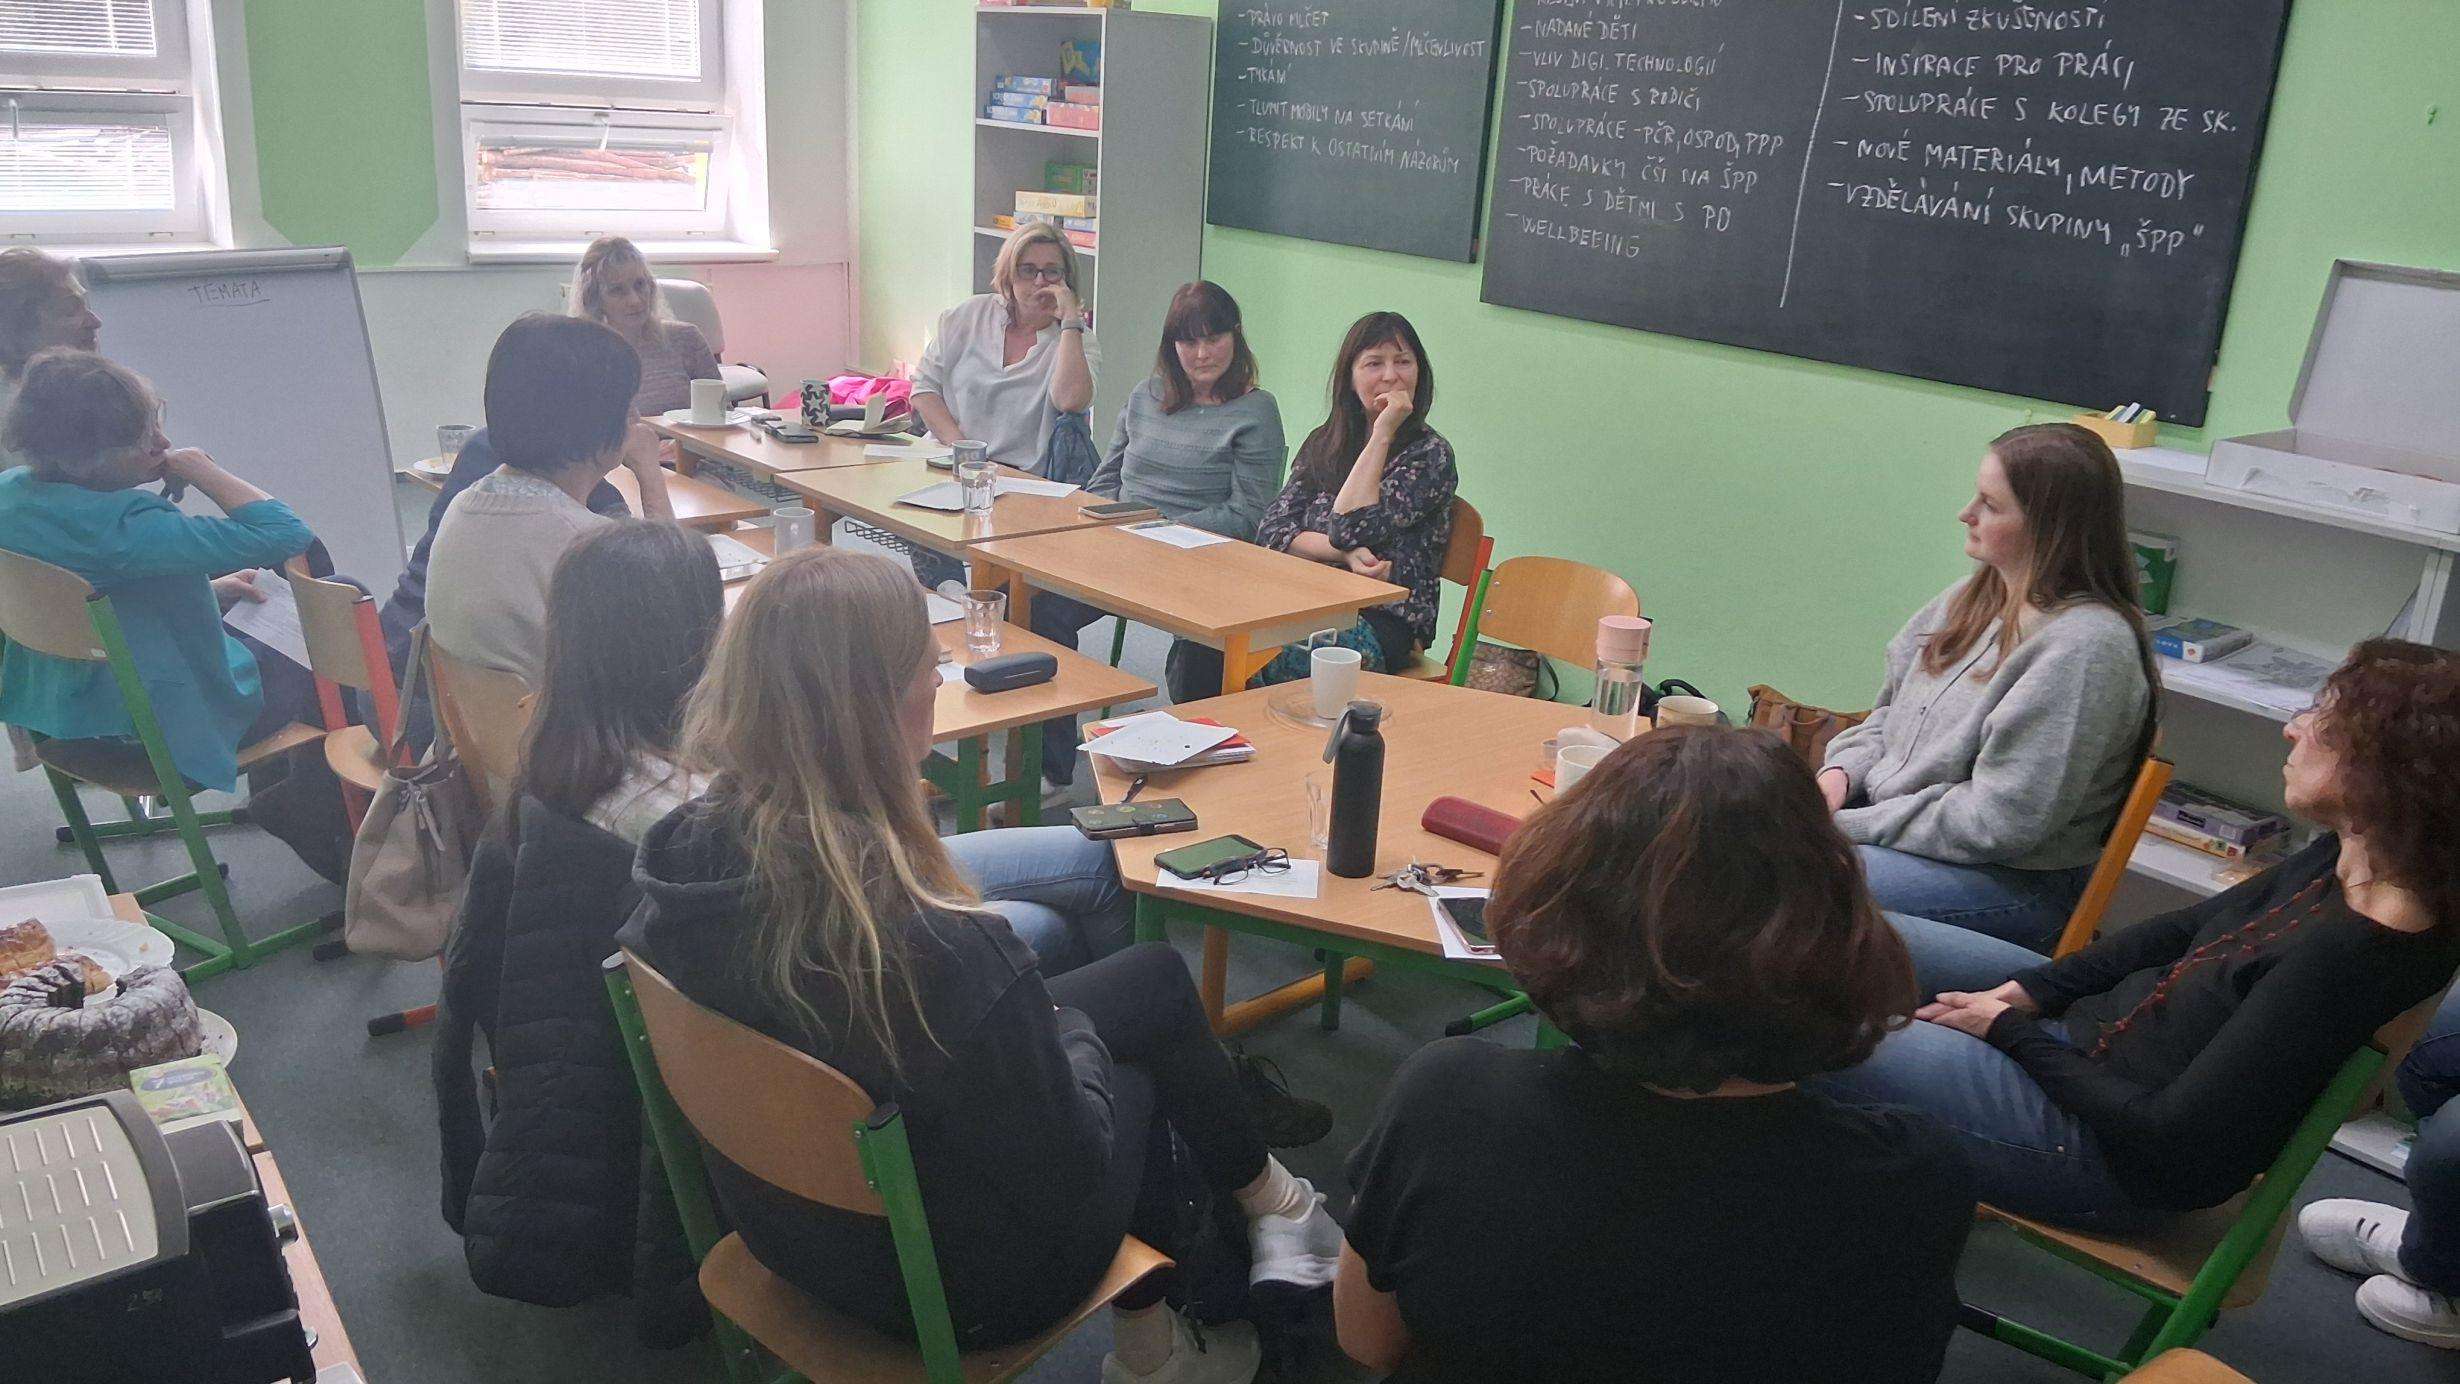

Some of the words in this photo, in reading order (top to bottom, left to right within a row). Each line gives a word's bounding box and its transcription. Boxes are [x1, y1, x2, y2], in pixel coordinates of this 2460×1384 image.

[1330, 37, 1344, 54] VE
[1995, 53, 2042, 77] PRO
[1631, 88, 1640, 106] S
[1334, 109, 1352, 126] NA
[2014, 97, 2028, 121] S
[2048, 101, 2140, 128] KOLEGY
[1311, 136, 1321, 156] K
[1744, 132, 1784, 156] PPP
[1720, 160, 1758, 194] ŠPP
[2080, 163, 2196, 201] METODY
[1582, 188, 1593, 206] S
[1672, 201, 1685, 222] S
[2006, 205, 2112, 246] SKUPINY
